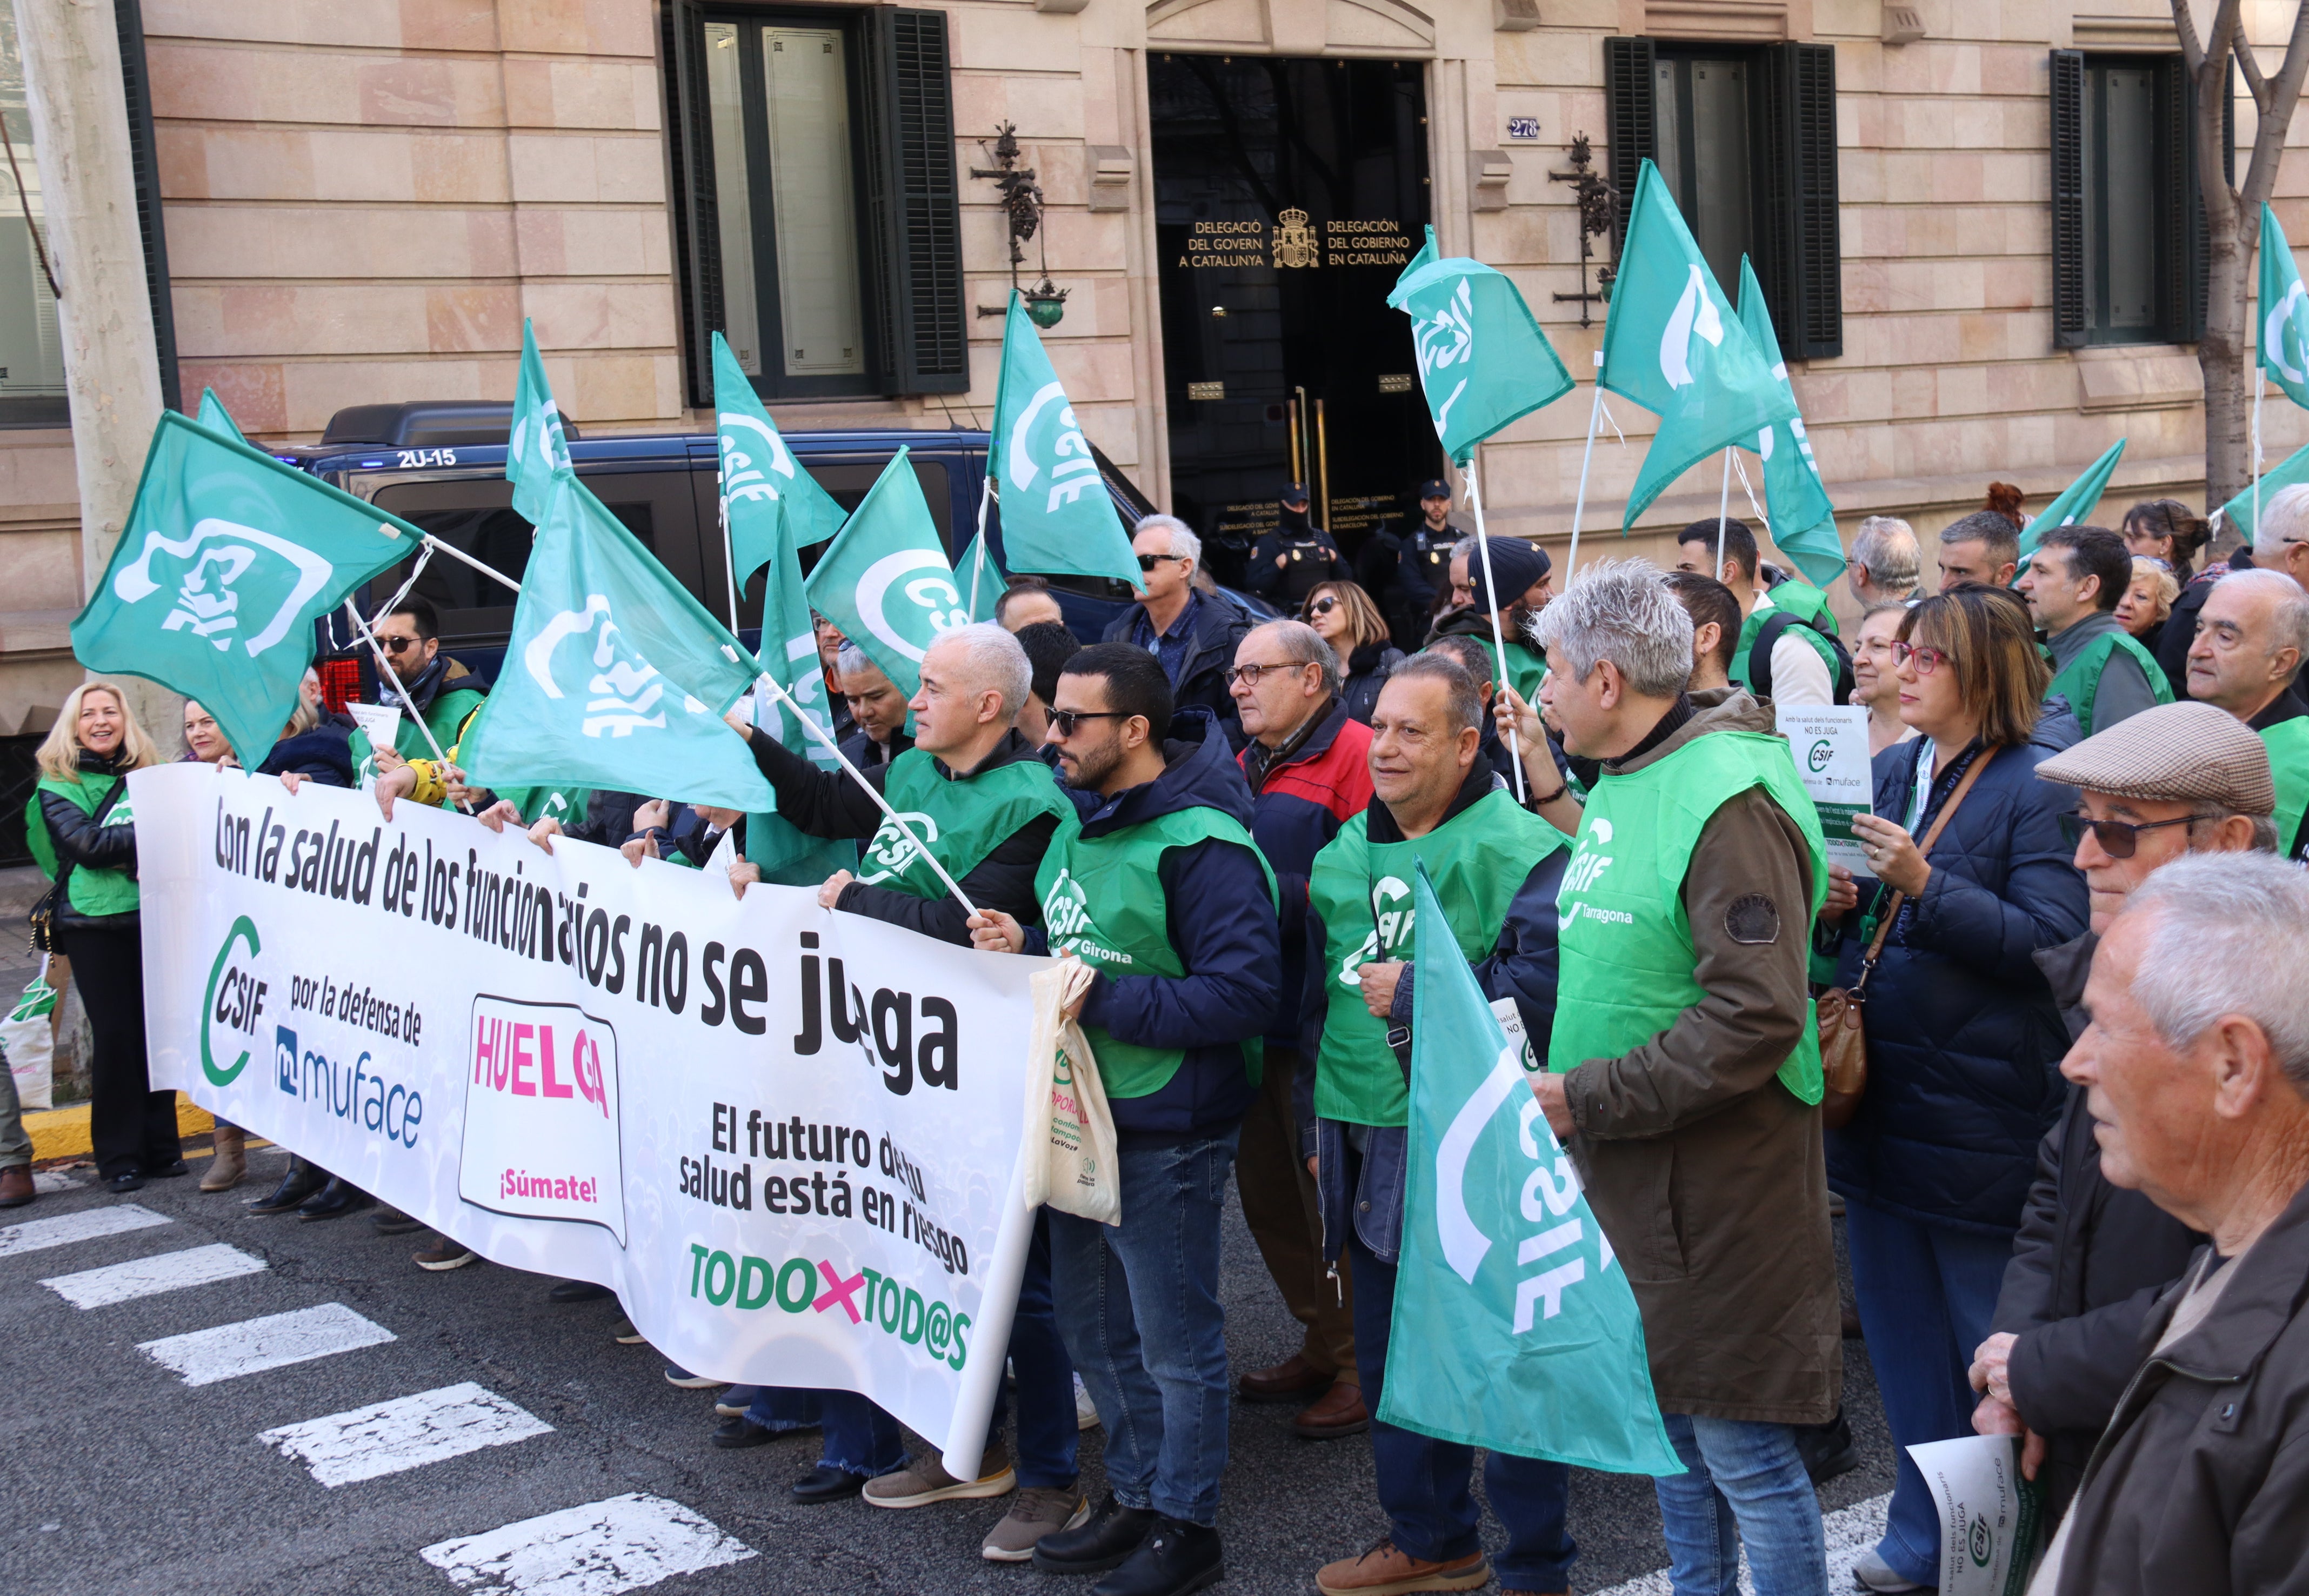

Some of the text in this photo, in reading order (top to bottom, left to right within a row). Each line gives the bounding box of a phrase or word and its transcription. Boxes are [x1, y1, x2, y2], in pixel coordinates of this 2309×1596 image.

[1511, 119, 1537, 136] 278
[1195, 219, 1262, 233] DELEGACIÓ
[1327, 218, 1399, 232] DELEGACIÓN
[1189, 238, 1263, 250] DEL GOVERN
[1328, 236, 1410, 249] DEL GOBIERNO
[1179, 255, 1264, 268] A CATALUNYA
[1329, 250, 1407, 265] EN CATALUÑA
[397, 449, 457, 469] 2U-15
[1804, 726, 1838, 735] NO ES JUGA
[1833, 777, 1860, 786] muface
[216, 794, 250, 876] Con
[255, 806, 286, 884] la
[284, 818, 382, 906] salud
[383, 831, 418, 918] de
[421, 838, 460, 930] los
[464, 847, 631, 995] funcionarios
[636, 922, 689, 1016] no
[700, 940, 768, 1036] se
[1582, 903, 1633, 924] Tarragona
[1080, 939, 1132, 964] Girona
[291, 973, 422, 1047] por la defensa de
[1500, 1012, 1517, 1024] salut
[1506, 1023, 1520, 1035] NO
[474, 1014, 610, 1120] HUELGA
[303, 1050, 423, 1150] muface
[712, 1101, 927, 1206] El futuro de tu
[499, 1167, 598, 1204] ¡Súmate!
[679, 1153, 969, 1276] salud está en riesgo
[1994, 1457, 2006, 1513] muface
[1936, 1471, 1957, 1529] funcionaris
[1956, 1502, 1966, 1574] NO ES JUGA
[1947, 1555, 1956, 1581] salut
